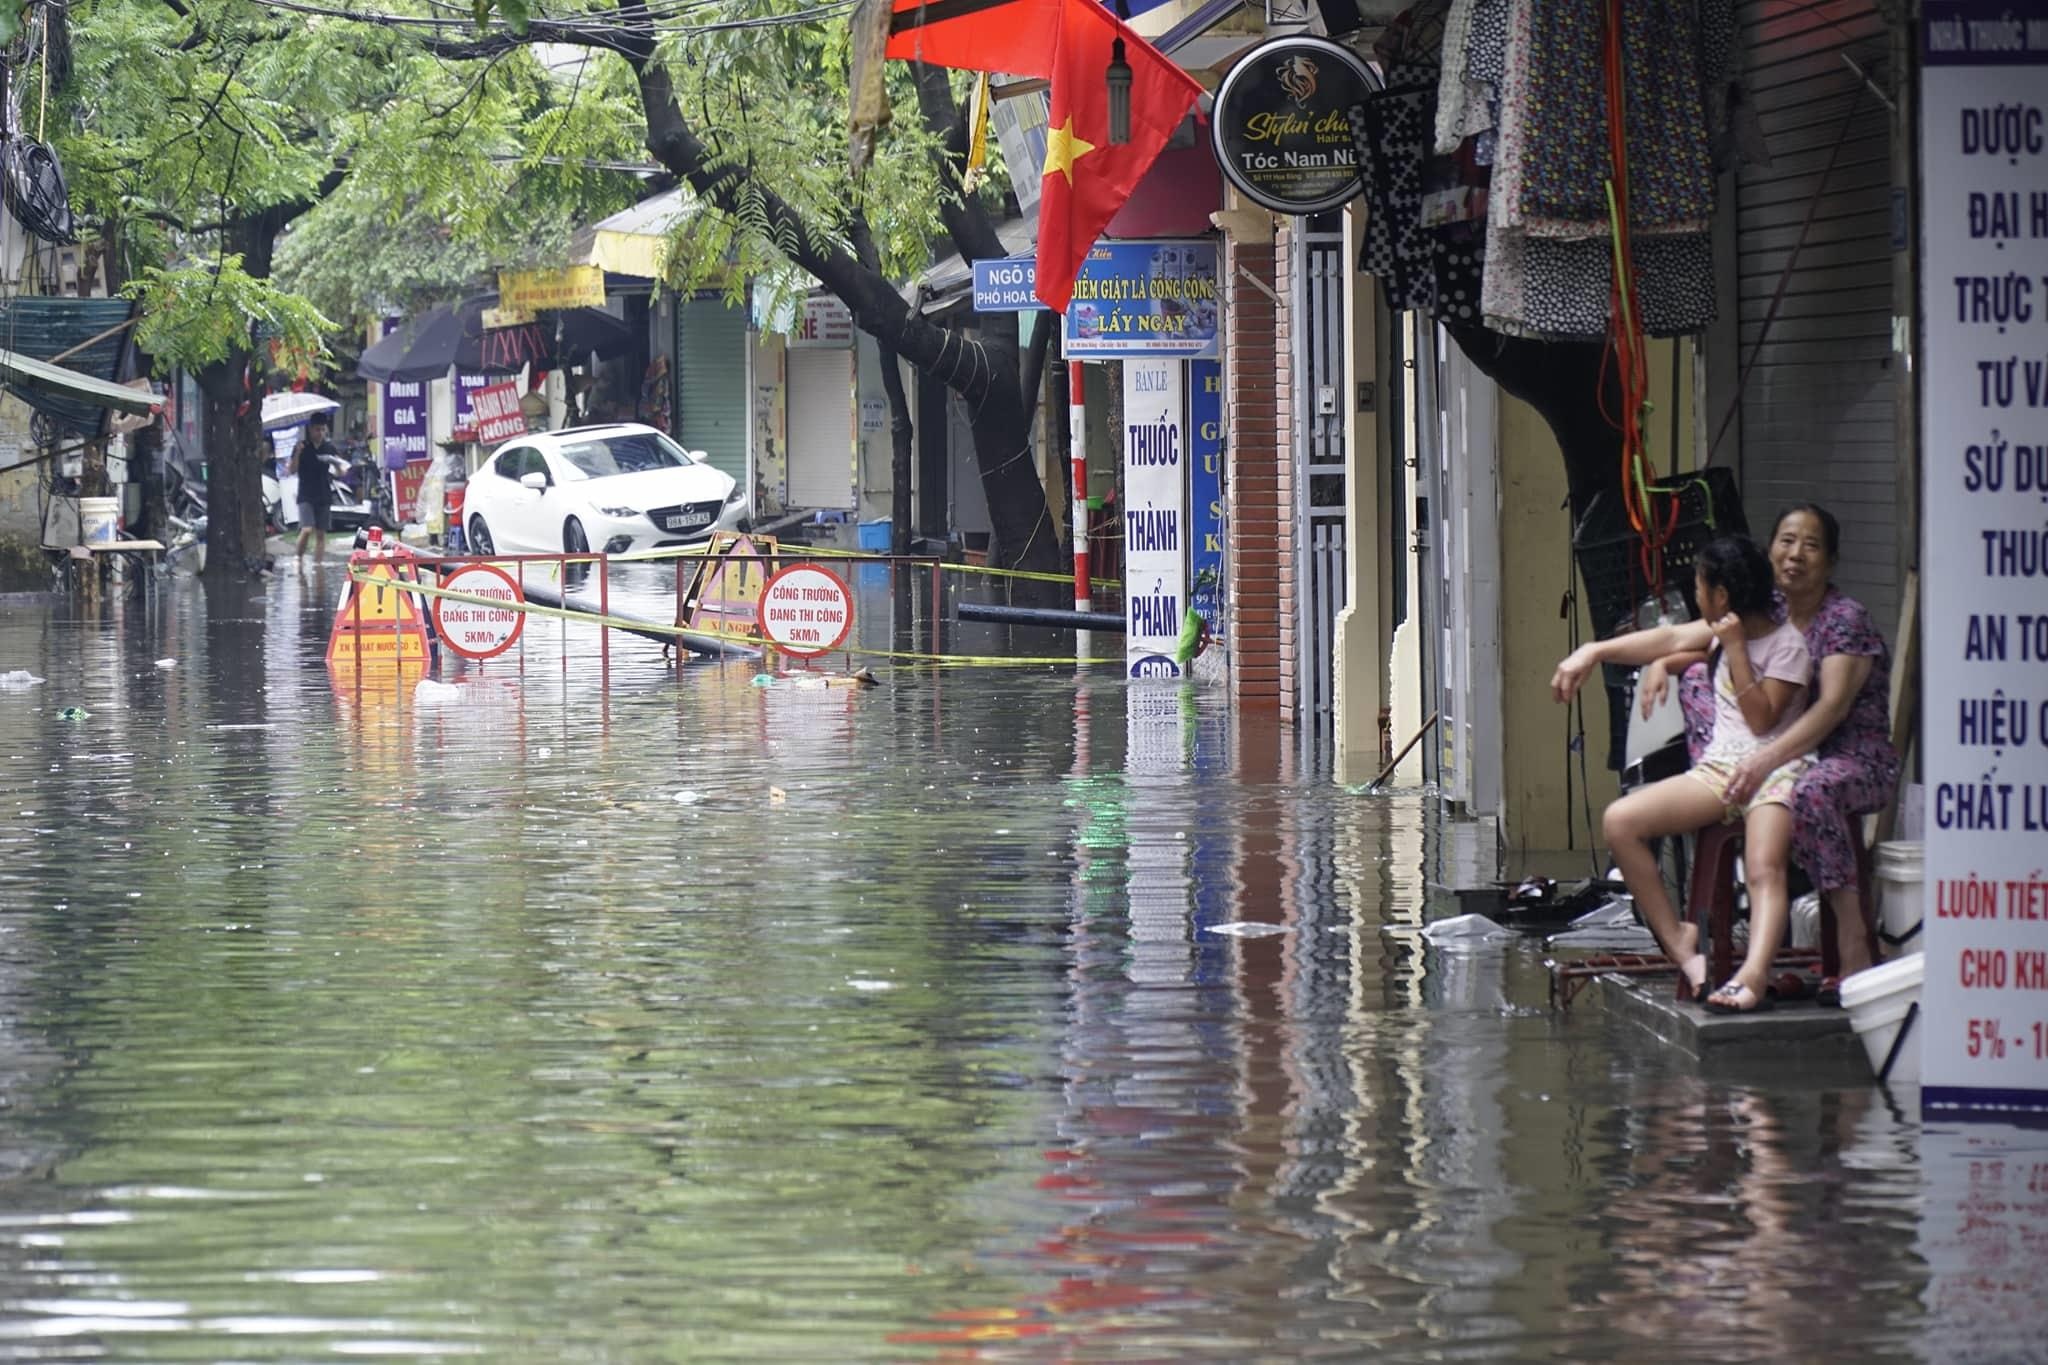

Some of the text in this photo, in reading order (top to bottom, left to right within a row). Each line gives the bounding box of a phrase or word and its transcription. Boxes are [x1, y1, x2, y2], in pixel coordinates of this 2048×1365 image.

[1316, 134, 1339, 144] Hair
[1961, 102, 2043, 166] DƯỢC
[1241, 152, 1279, 169] Tóc
[1284, 151, 1327, 167] Nam
[1968, 191, 2020, 250] ĐẠI
[989, 264, 1024, 286] NGÕ
[1101, 273, 1129, 304] GIẶT
[1131, 273, 1147, 300] LÀ
[1150, 272, 1181, 300] CÔNG
[977, 287, 1001, 305] PHỐ
[1003, 290, 1028, 304] HOA
[1954, 270, 2032, 335] TRỰC
[1098, 307, 1186, 332] LẤY NGAY
[1135, 366, 1154, 392] BÁN
[1977, 355, 2019, 408] TƯ
[394, 406, 416, 425] GIÁ
[482, 417, 525, 440] NÓNG
[1129, 409, 1178, 466] THUỐC
[1964, 428, 2008, 492] SỬ
[1127, 501, 1178, 552] THÀNH
[773, 585, 839, 603] CÔNG TRƯỜNG
[1132, 578, 1178, 637] PHẨM
[443, 610, 468, 623] ĐANG
[472, 610, 486, 622] THI
[770, 609, 843, 623] ĐANG THI CÔNG
[465, 631, 495, 643] 5KM/h
[790, 629, 820, 642] 5KM/h
[1965, 614, 2007, 661] AN
[1959, 688, 2027, 757] HIỆU
[1936, 765, 2013, 830] CHẤT
[1937, 871, 1997, 919] LUÔN
[1960, 949, 2006, 989] CHO
[1967, 1019, 2006, 1059] 5%
